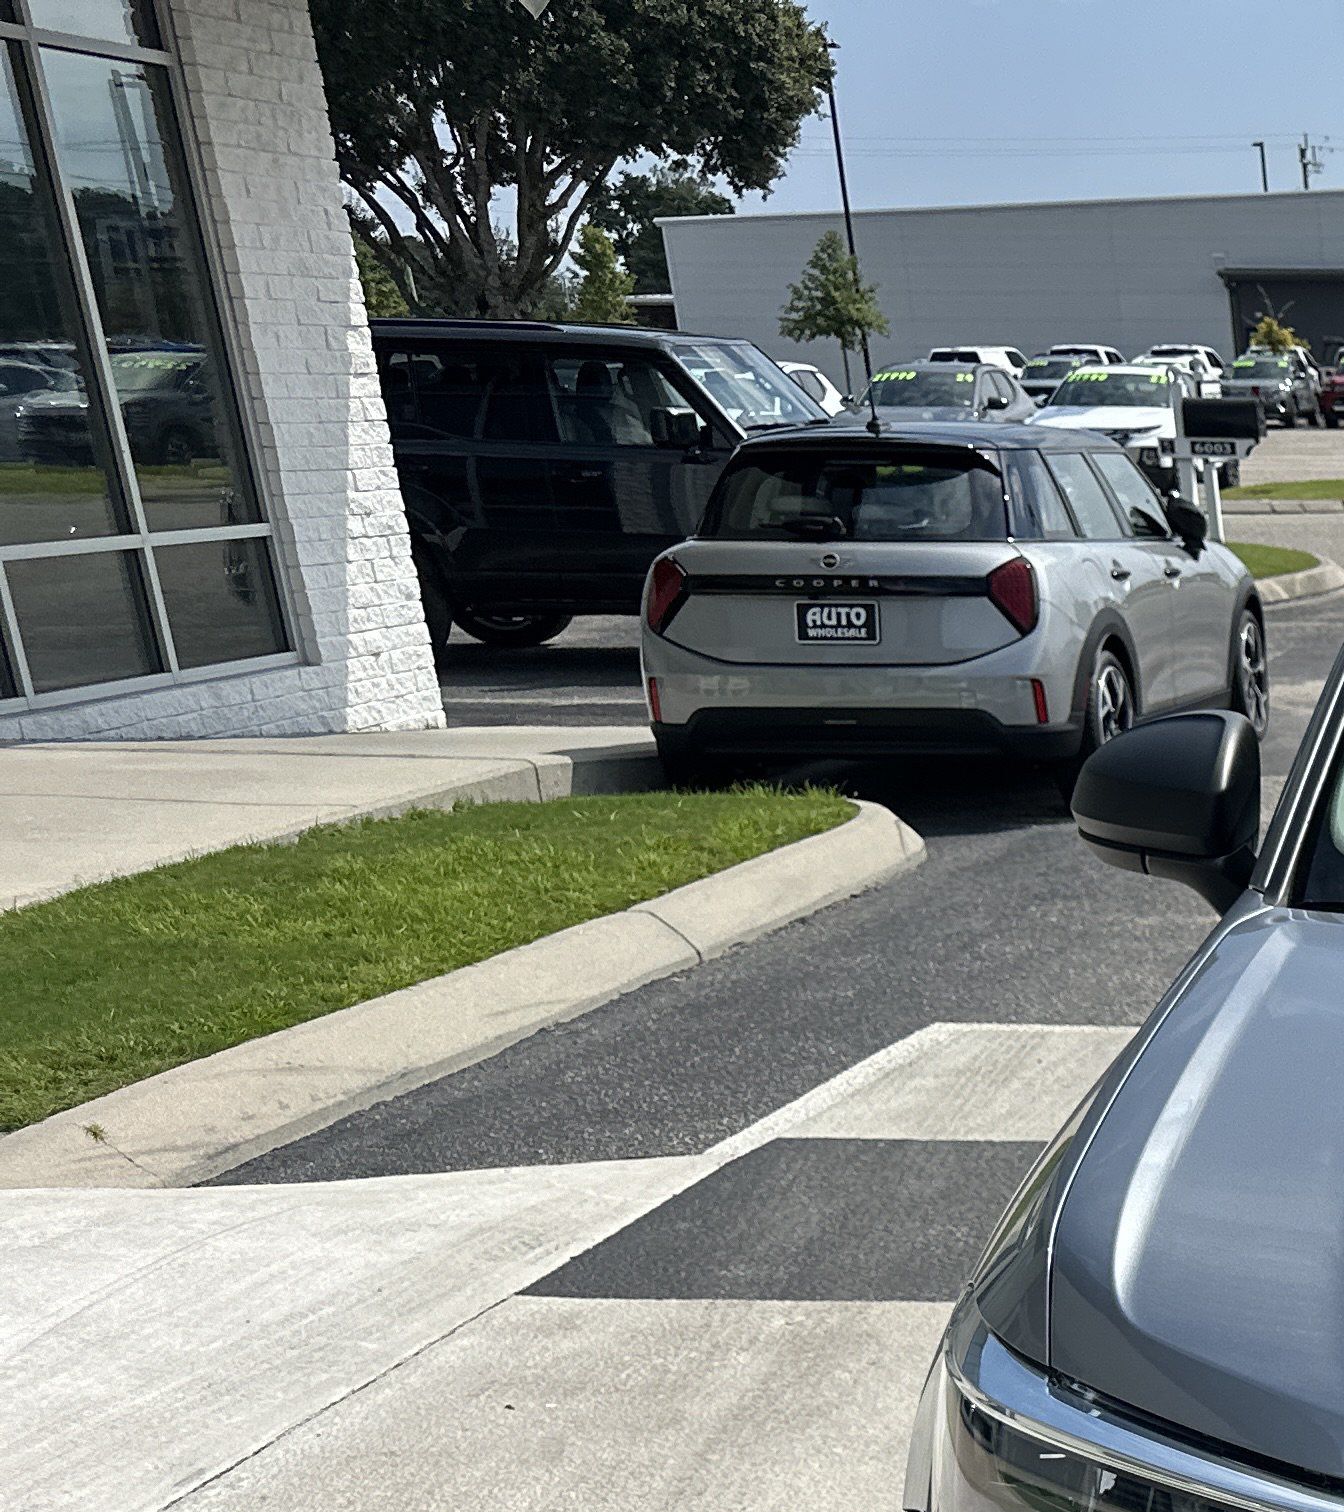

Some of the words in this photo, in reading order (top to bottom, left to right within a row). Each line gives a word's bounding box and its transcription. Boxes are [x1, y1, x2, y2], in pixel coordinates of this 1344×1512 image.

[775, 579, 879, 588] COOPER
[806, 607, 867, 627] AUTO
[807, 627, 868, 638] WHOLESALE
